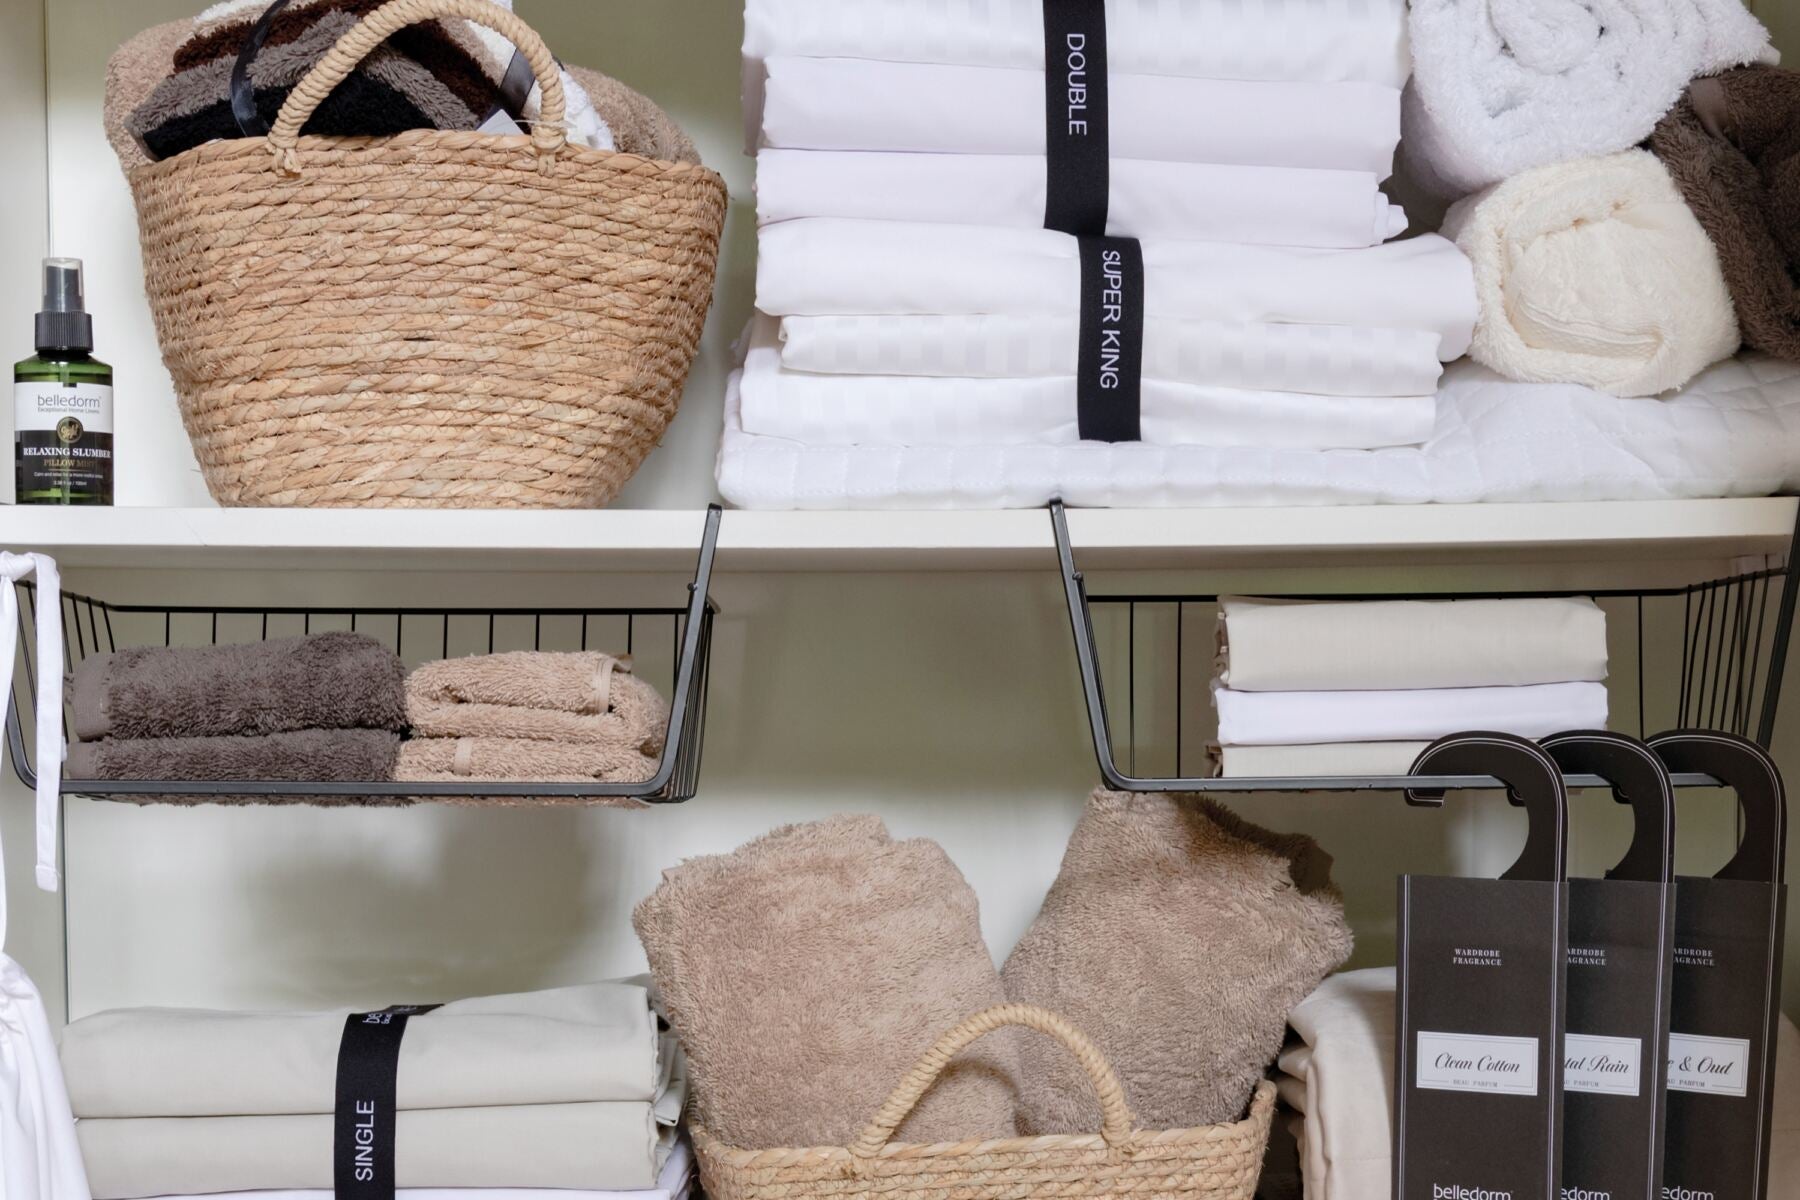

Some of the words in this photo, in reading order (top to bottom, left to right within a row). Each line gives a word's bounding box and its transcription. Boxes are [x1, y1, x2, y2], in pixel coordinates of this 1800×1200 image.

[1067, 33, 1087, 136] DOUBLE
[1101, 250, 1122, 323] SUPER
[1099, 329, 1121, 389] KING
[37, 394, 101, 408] belledorm
[23, 447, 70, 456] RELAXING
[72, 447, 111, 458] SLUMBER
[43, 459, 75, 467] PILLOW
[1454, 948, 1500, 957] WARDROBE
[1453, 957, 1502, 966] FRAGRANCE
[1434, 1051, 1473, 1070] Clean
[1477, 1054, 1521, 1073] Cotton
[1587, 1055, 1629, 1073] Rain
[1679, 1056, 1692, 1072] &
[1697, 1056, 1734, 1075] Oud
[1473, 1080, 1498, 1088] PARFUM
[1573, 1079, 1599, 1087] PARFUM
[1679, 1079, 1705, 1087] PARFUM
[354, 1100, 375, 1181] SINGLE
[1433, 1183, 1511, 1200] belledorm
